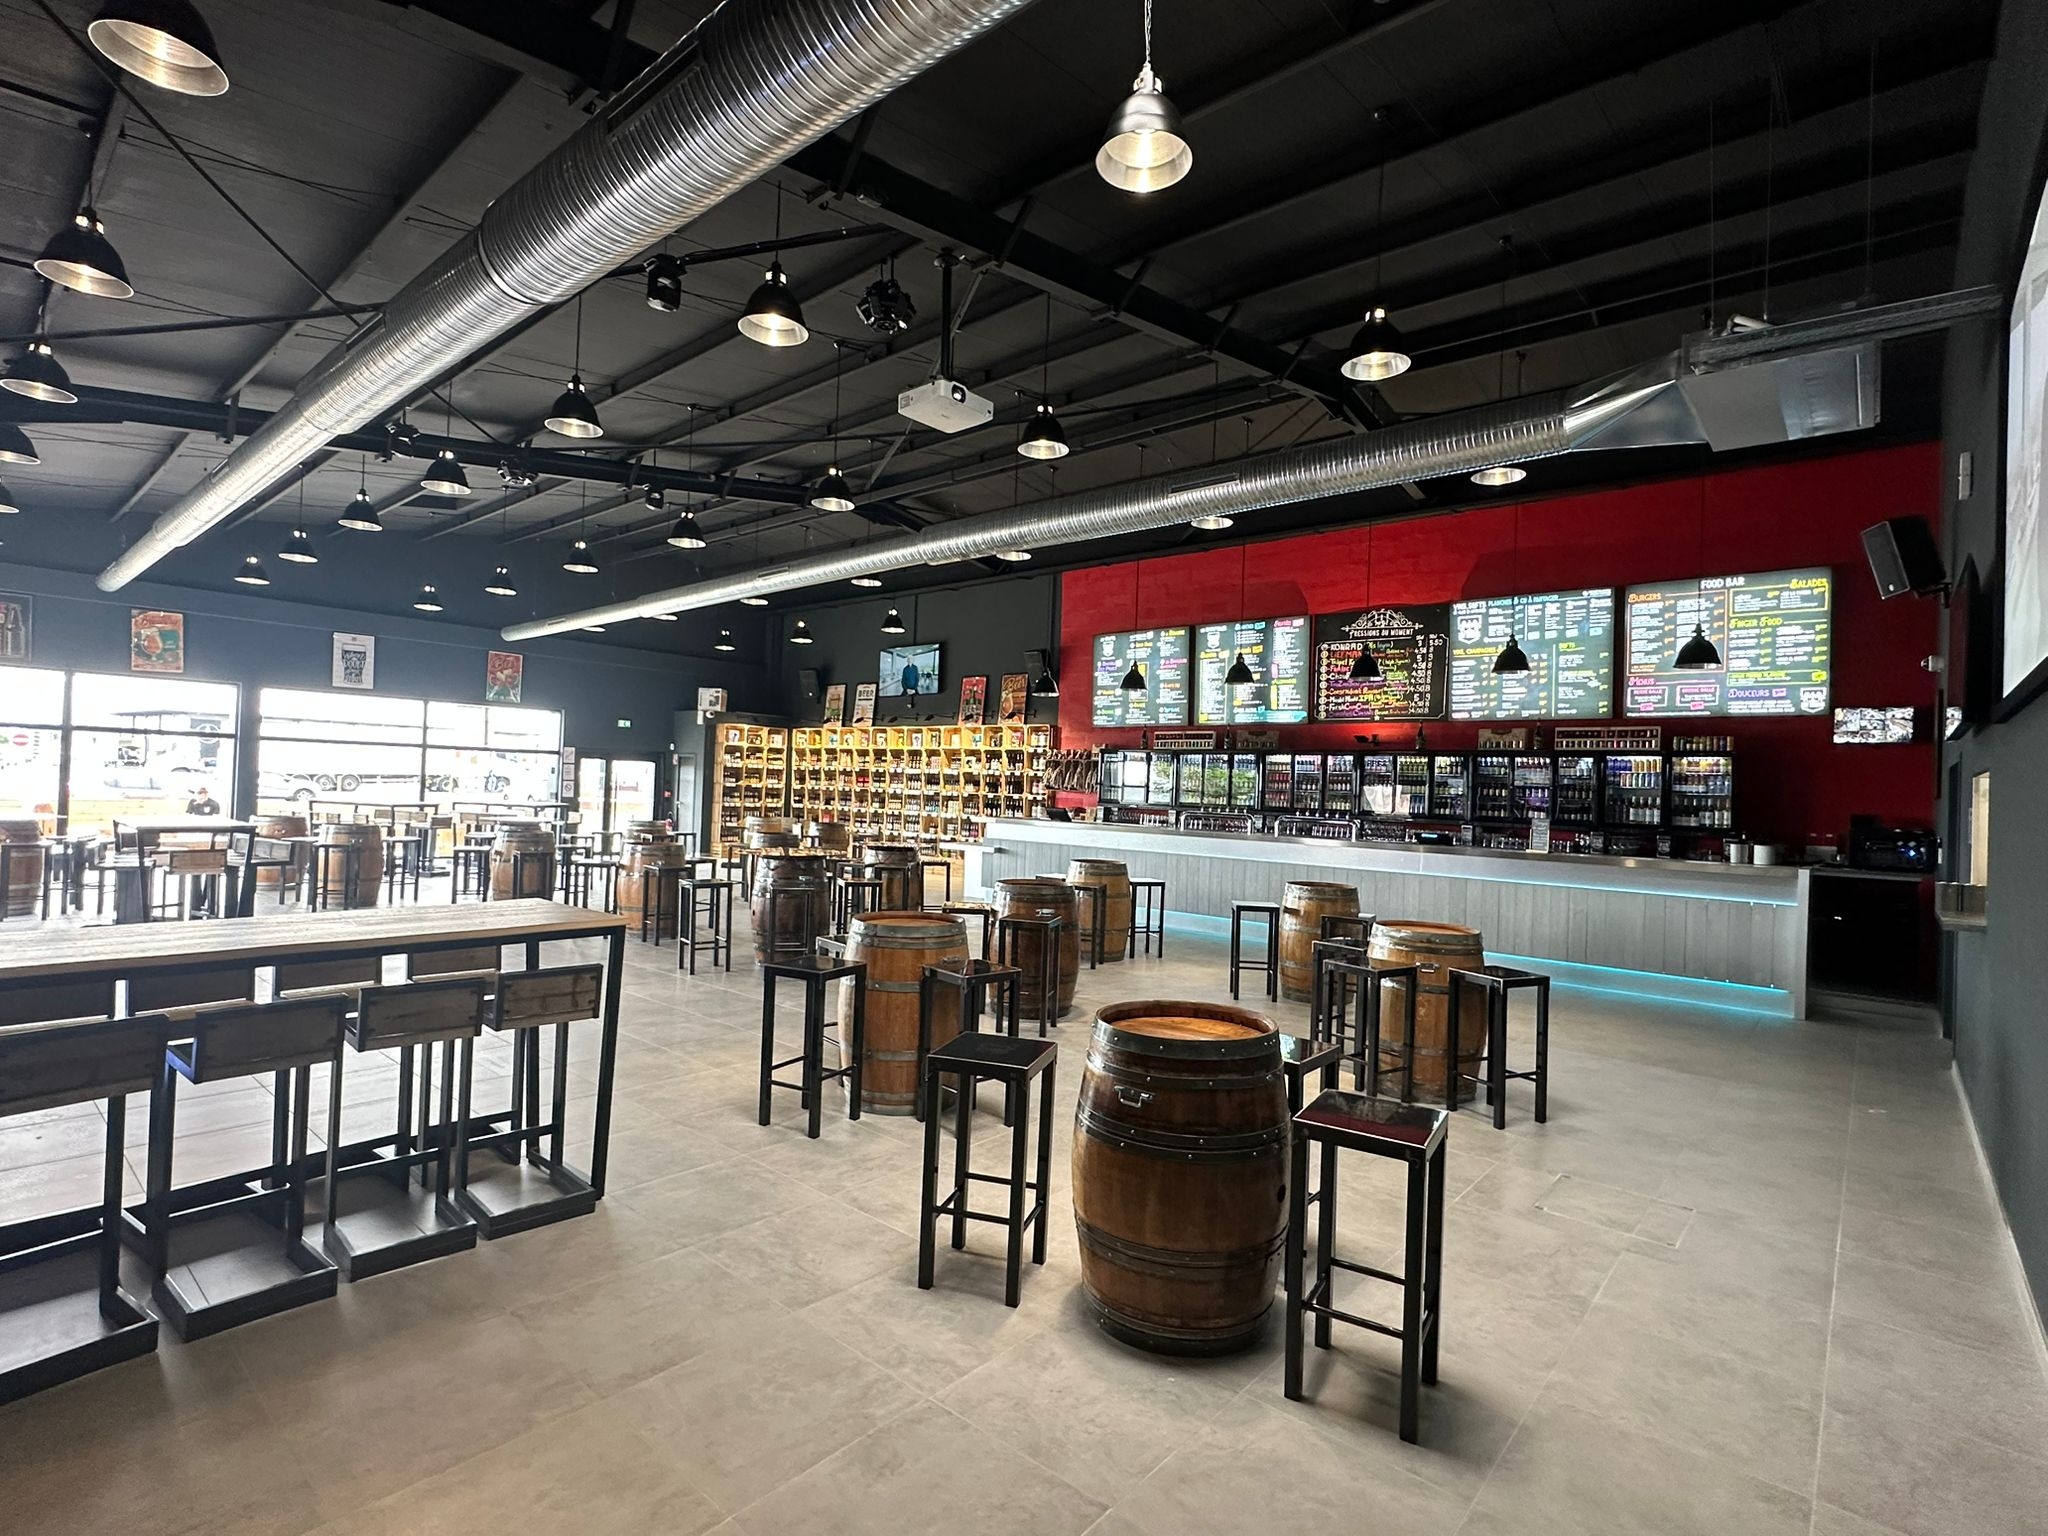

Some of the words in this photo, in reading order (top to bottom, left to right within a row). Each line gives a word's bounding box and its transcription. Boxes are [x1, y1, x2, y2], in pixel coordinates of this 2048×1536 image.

[1701, 578, 1724, 589] FOOD
[1725, 576, 1745, 588] BAR
[1789, 577, 1828, 589] SALADES
[1628, 593, 1662, 603] BURGERS
[1729, 618, 1758, 629] FINGER
[1760, 616, 1783, 627] FOOD
[1728, 689, 1770, 698] DOUCEURS
